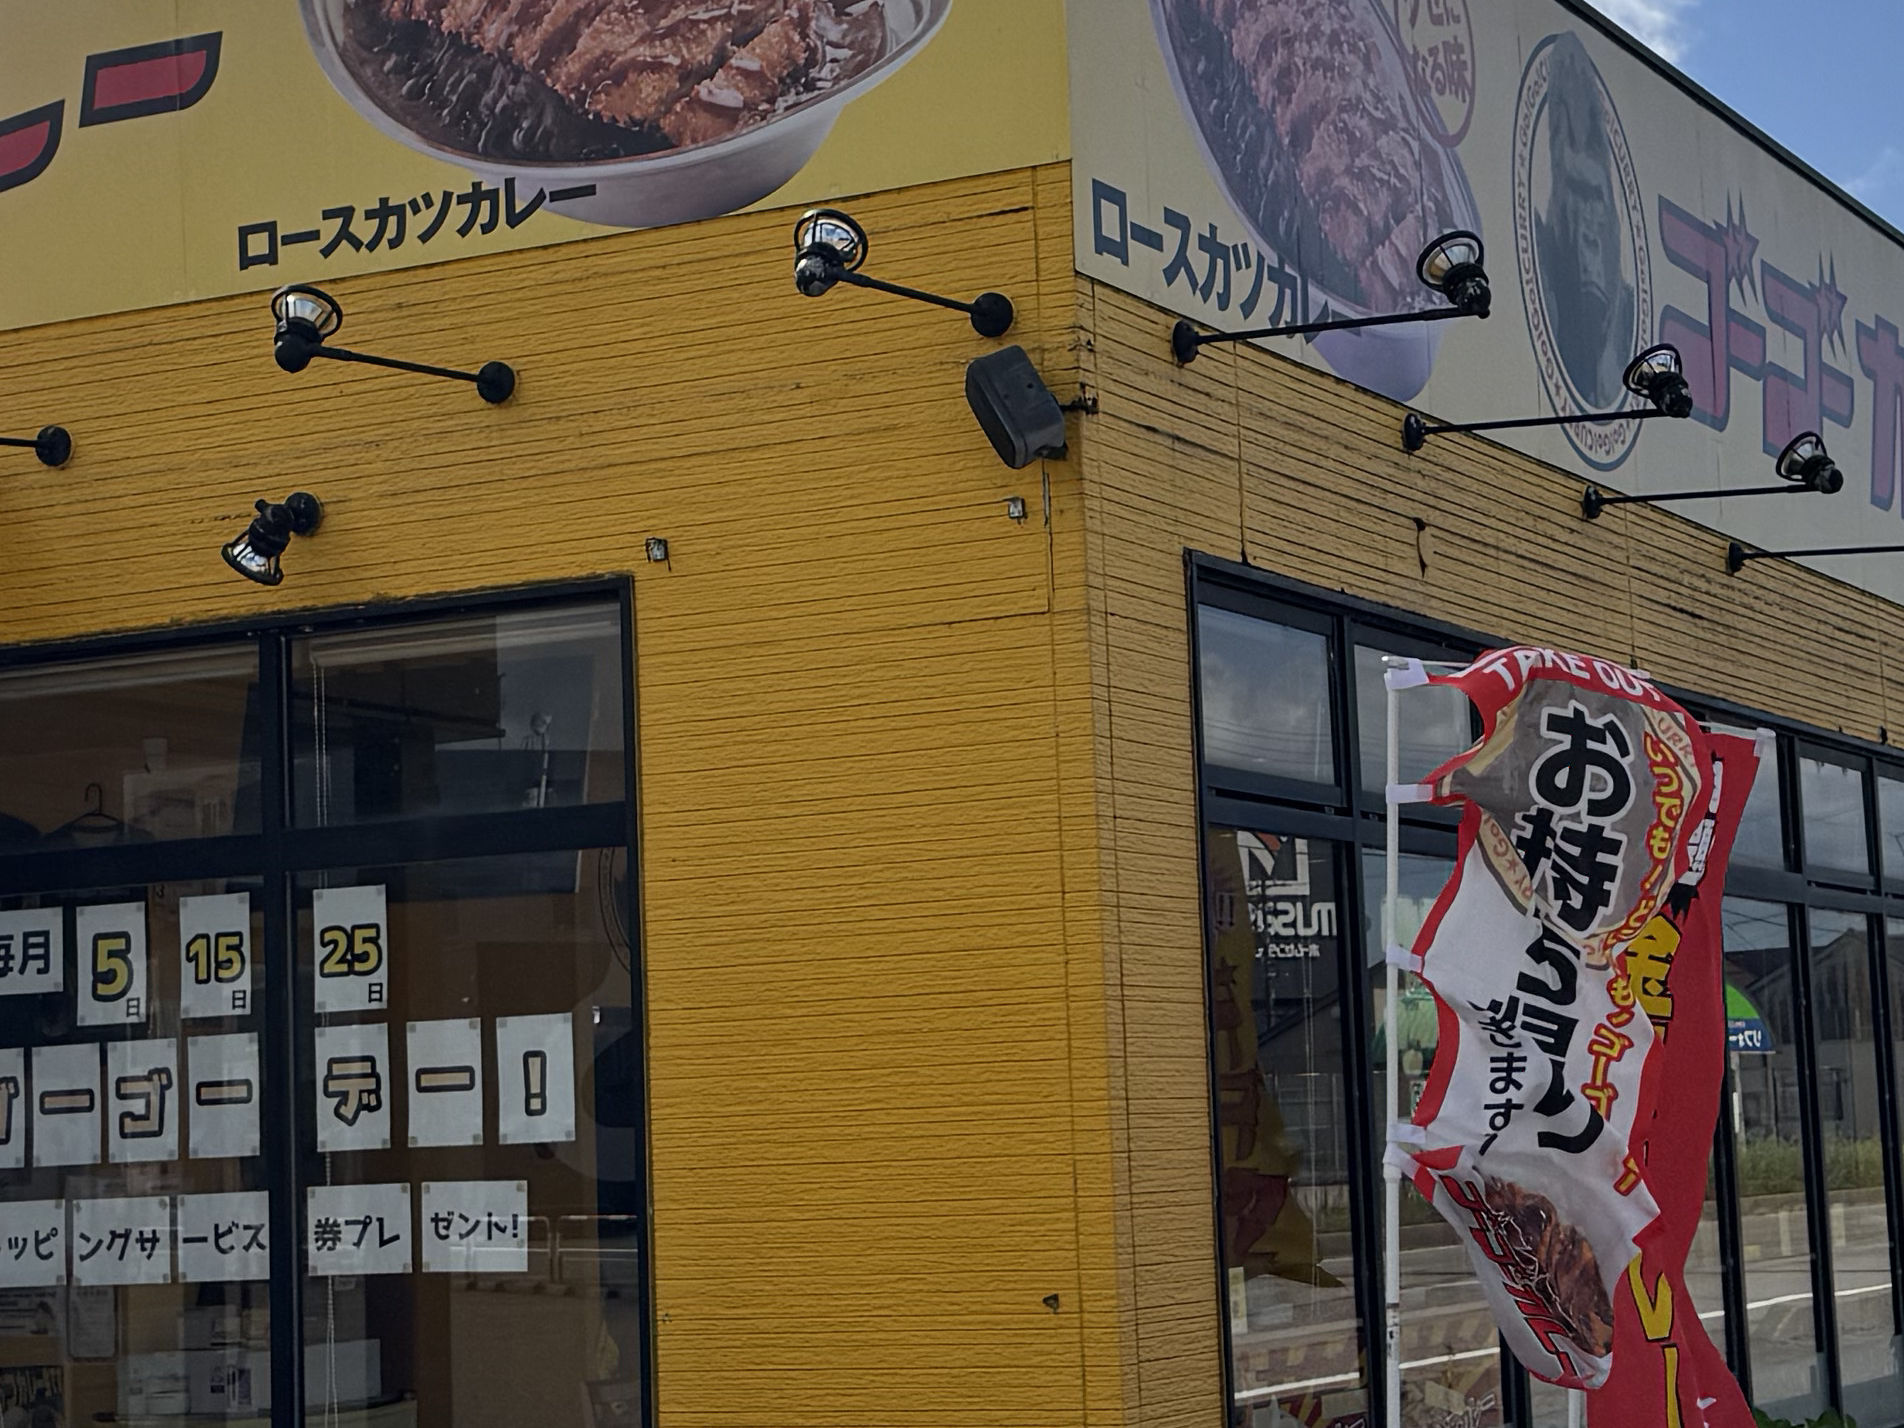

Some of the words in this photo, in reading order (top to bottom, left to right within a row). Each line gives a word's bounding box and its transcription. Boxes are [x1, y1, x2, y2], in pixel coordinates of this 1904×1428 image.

[237, 177, 597, 271] ロースカツカレー
[1482, 648, 1591, 692] TAKE
